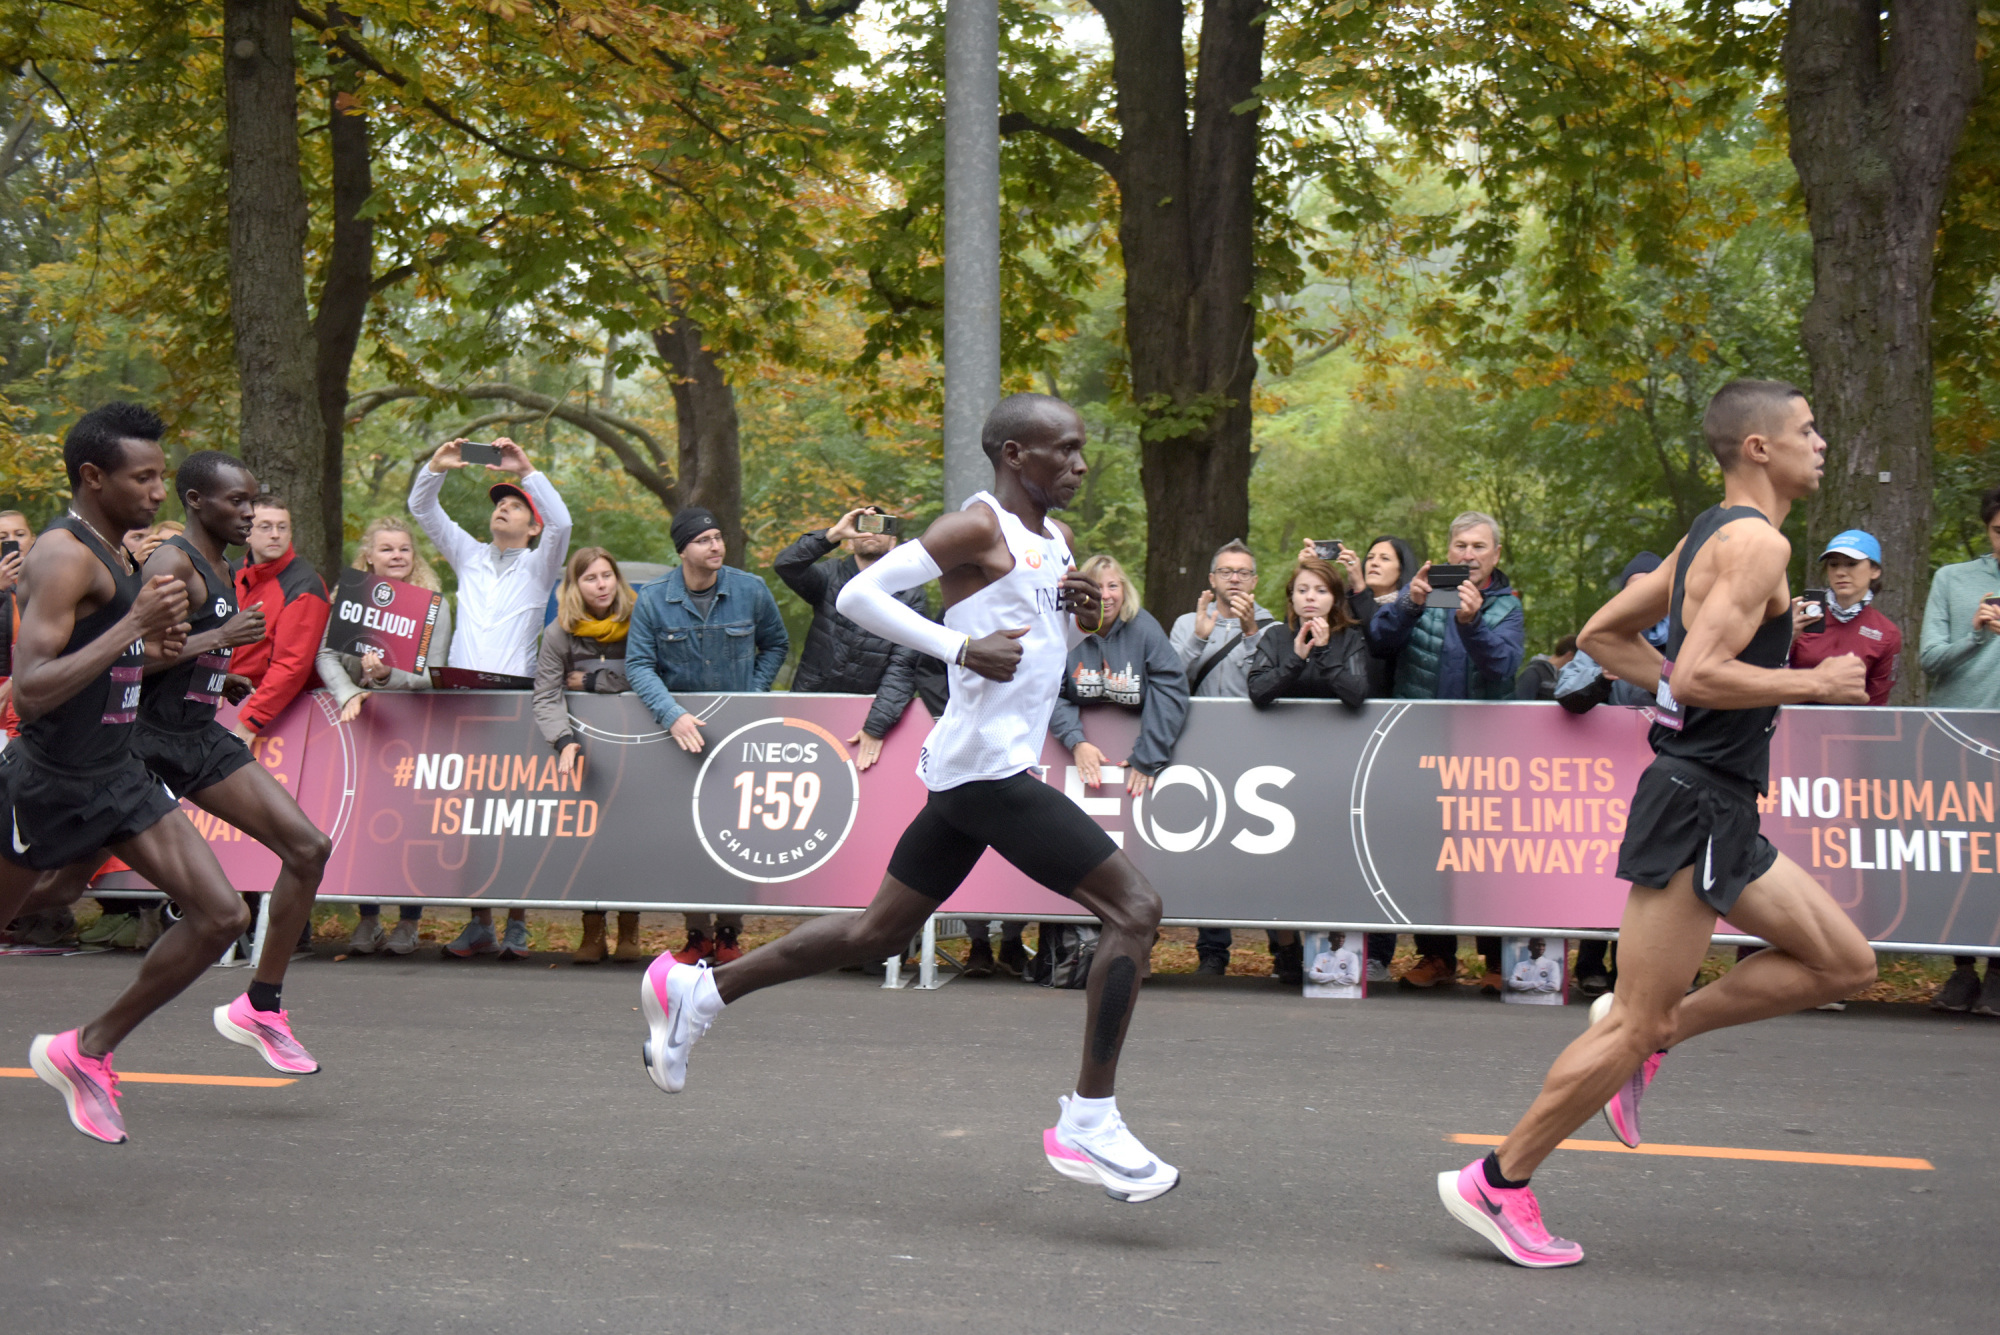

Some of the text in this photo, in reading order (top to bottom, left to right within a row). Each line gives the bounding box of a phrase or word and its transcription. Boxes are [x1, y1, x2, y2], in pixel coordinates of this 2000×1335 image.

[339, 600, 416, 640] GO ELIUD!
[1036, 587, 1068, 614] INE
[393, 753, 585, 792] #NOHUMAN
[741, 742, 819, 764] INEOS
[1419, 755, 1615, 793] "WHO SETS
[431, 797, 599, 837] ISLIMITED
[733, 770, 821, 831] 1:59
[1040, 763, 1297, 855] EOS
[1436, 796, 1628, 834] THE LIMITS
[719, 828, 828, 865] CHALLENGE
[1811, 826, 2000, 874] ISLIMITE
